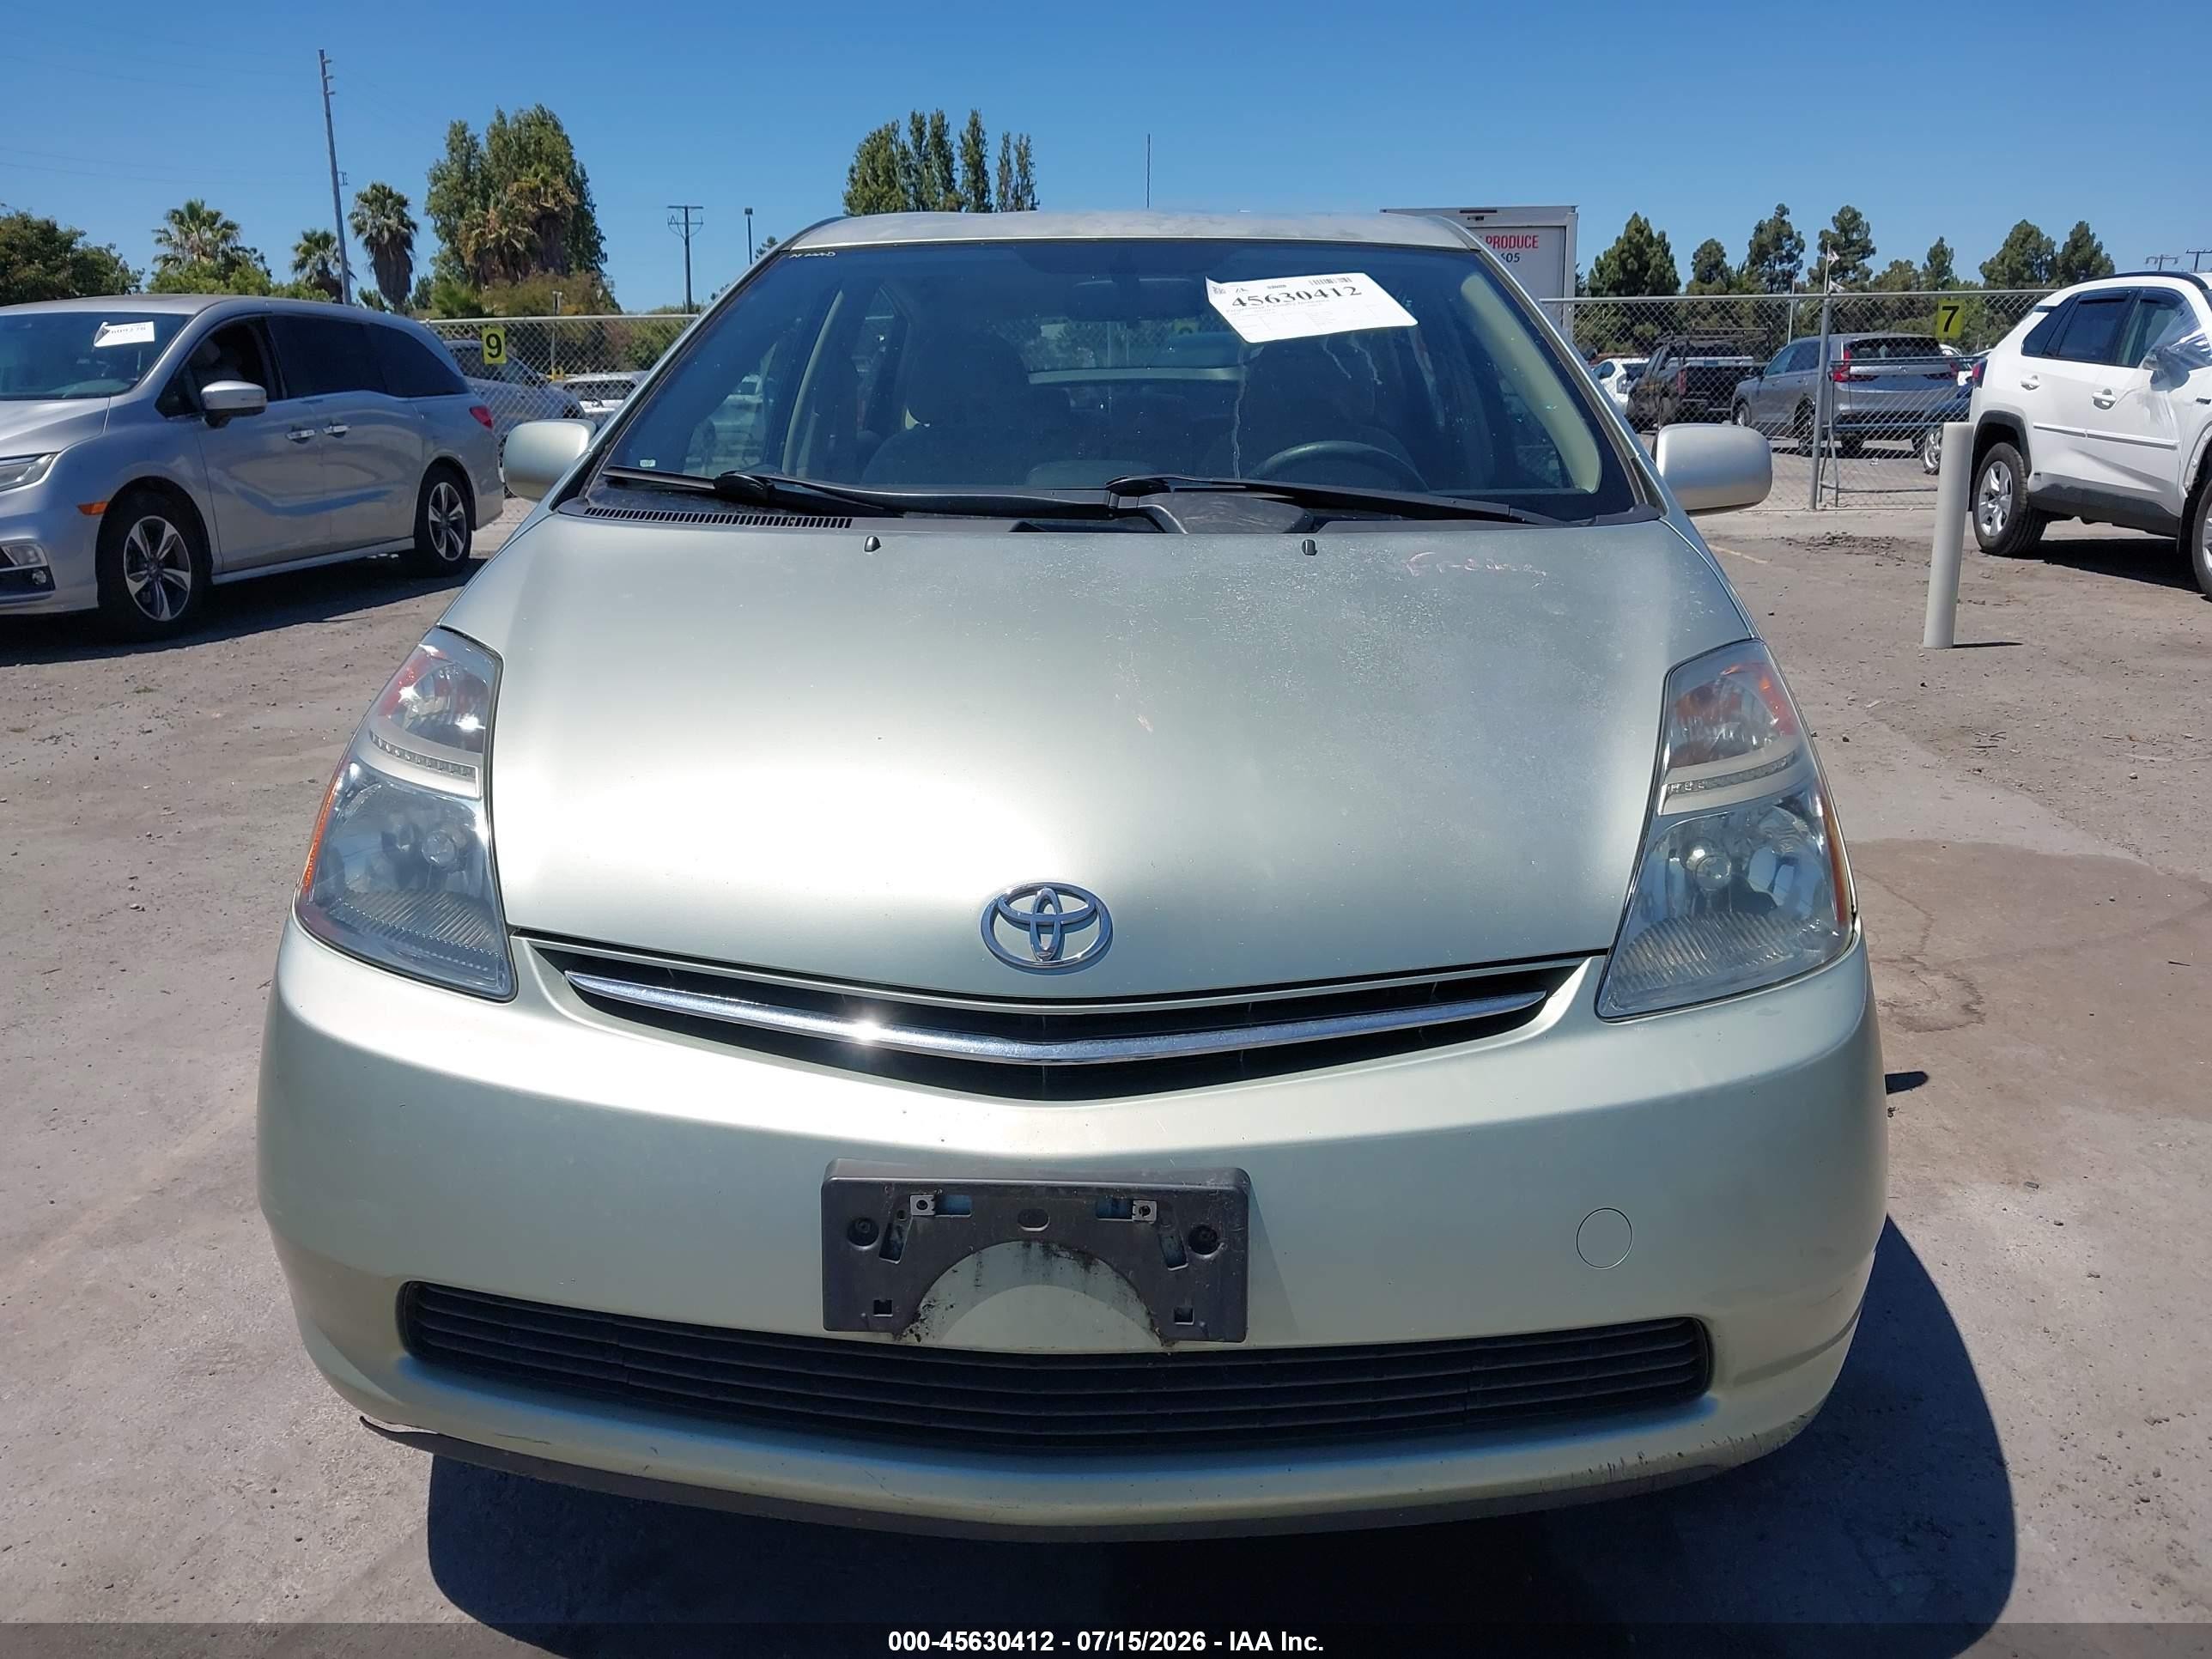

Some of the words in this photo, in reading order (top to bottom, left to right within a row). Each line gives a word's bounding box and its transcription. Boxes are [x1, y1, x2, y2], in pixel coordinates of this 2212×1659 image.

[1486, 234, 1540, 249] PRODUCE
[1231, 285, 1363, 307] 45630412
[1942, 305, 1960, 333] 7
[485, 333, 502, 359] 9
